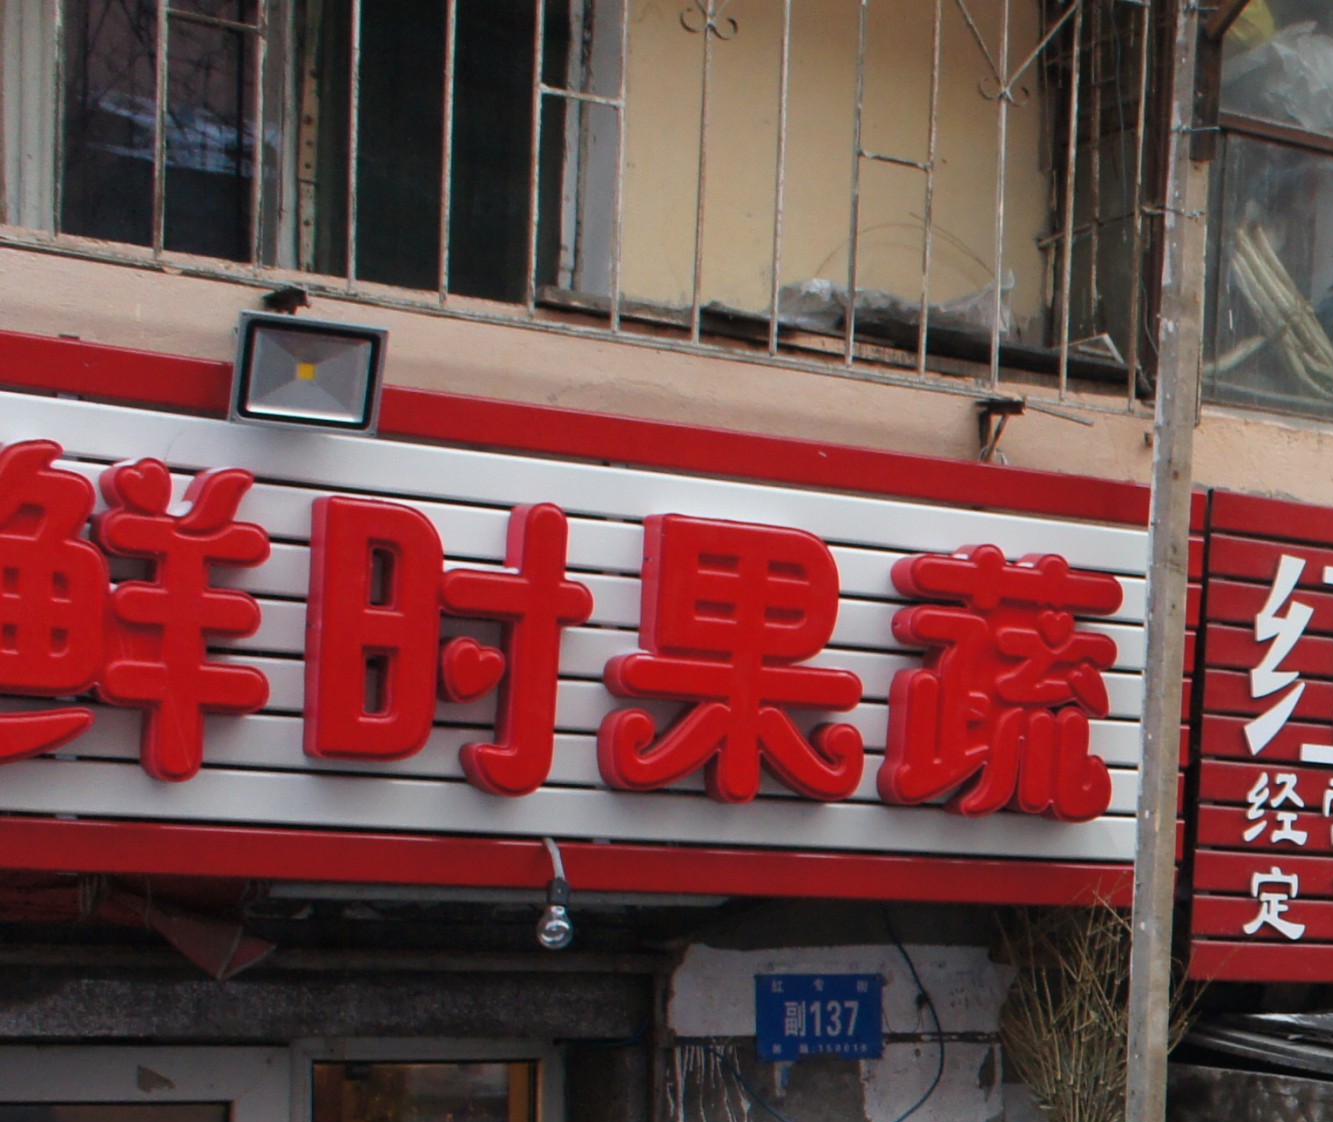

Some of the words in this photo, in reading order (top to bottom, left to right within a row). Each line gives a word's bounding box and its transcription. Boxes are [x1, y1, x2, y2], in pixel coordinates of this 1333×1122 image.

[0, 439, 1122, 823] 鲜时果蔬
[784, 1000, 860, 1037] 副137
